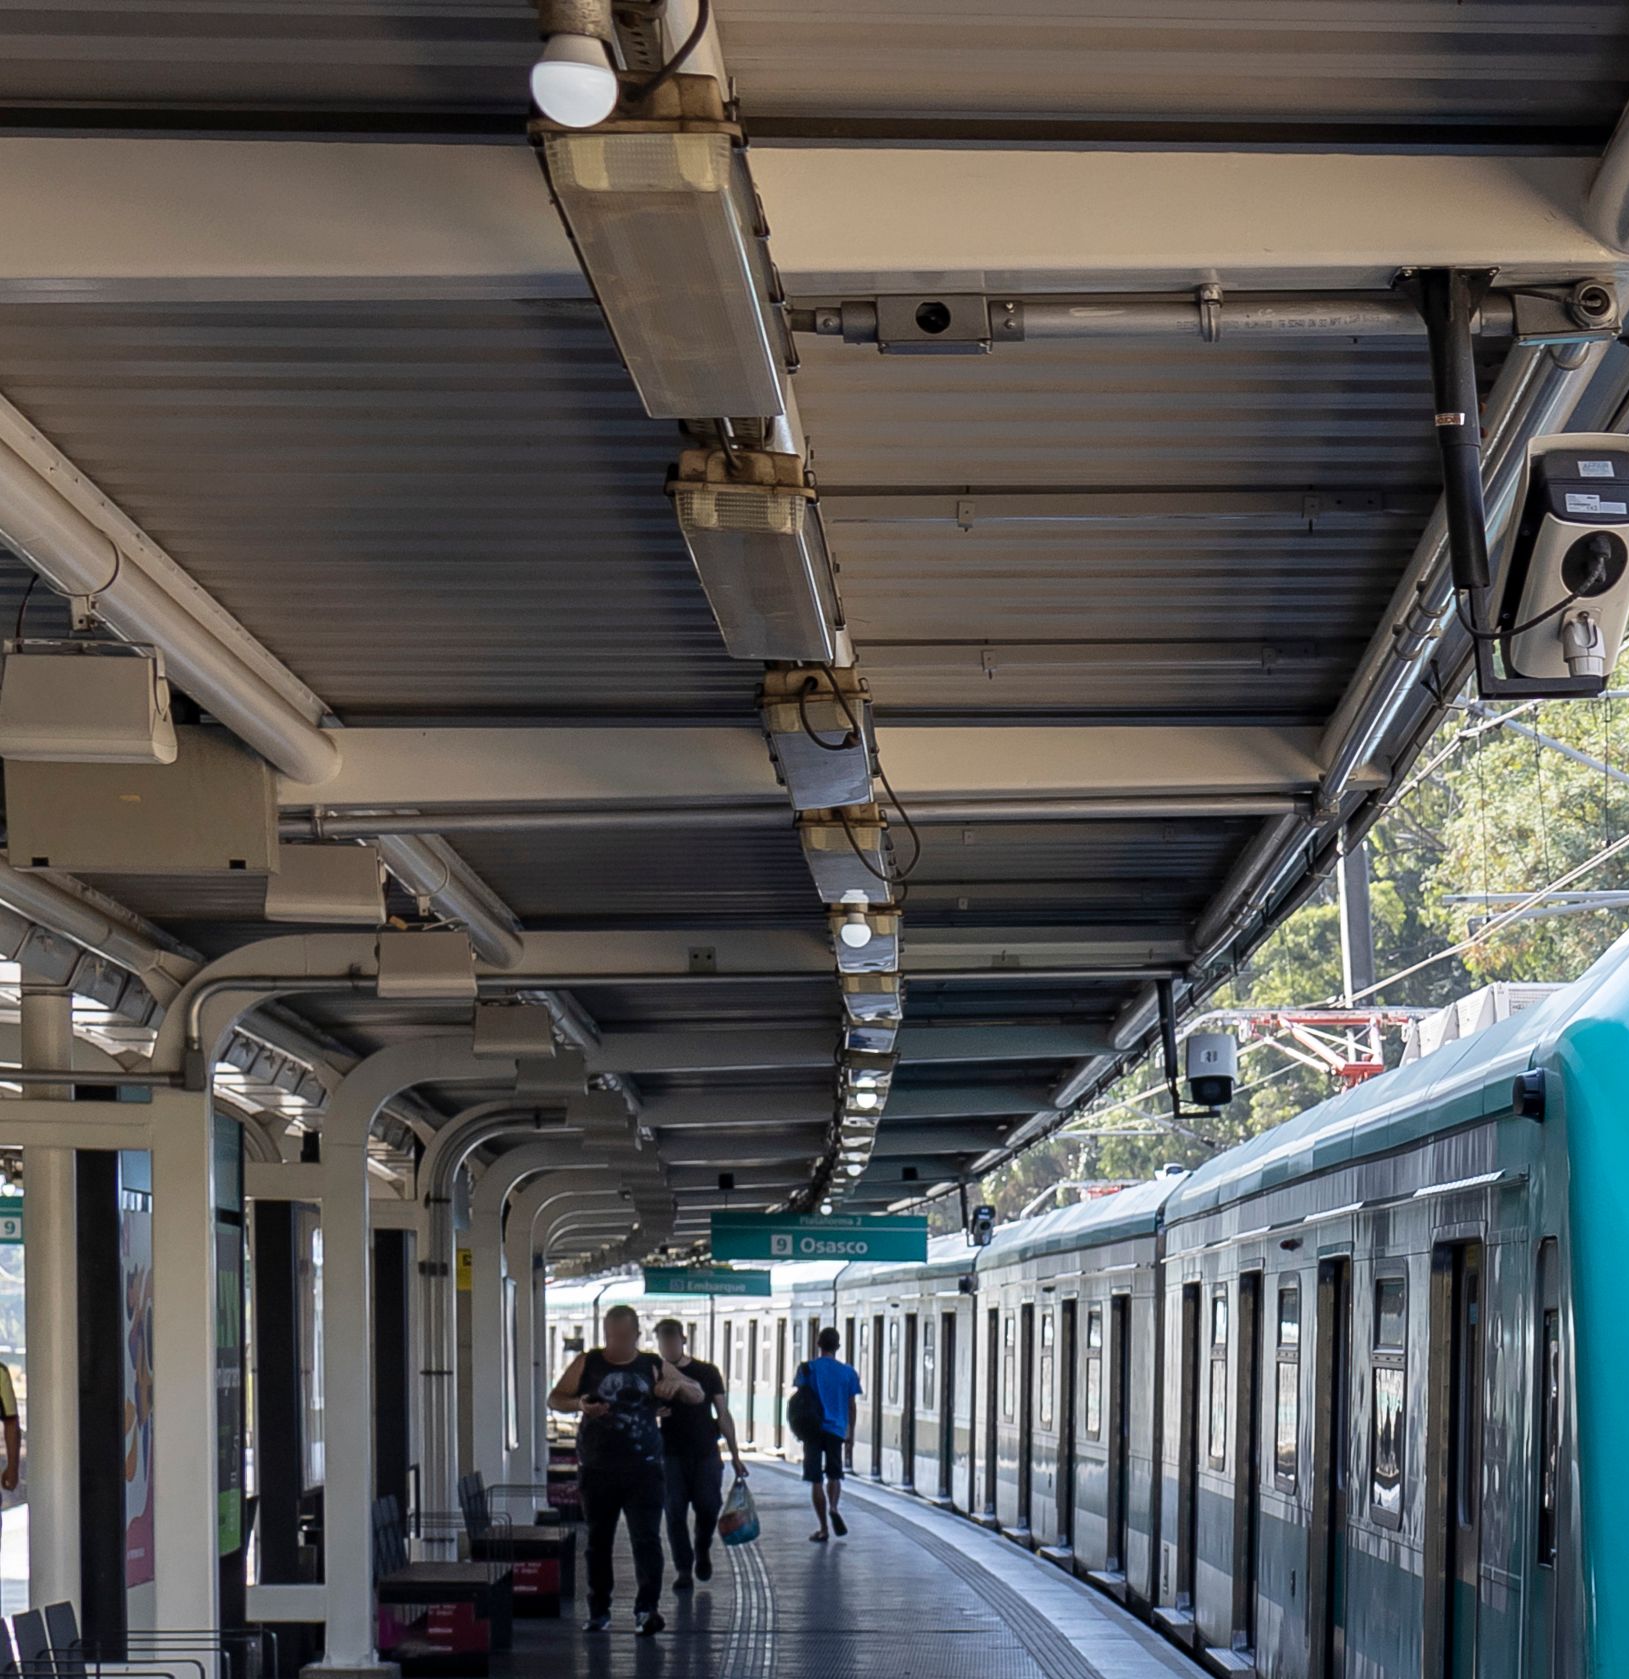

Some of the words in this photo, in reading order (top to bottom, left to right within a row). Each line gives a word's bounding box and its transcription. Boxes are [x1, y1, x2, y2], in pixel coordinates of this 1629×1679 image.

[4, 1220, 15, 1235] 9
[856, 1217, 862, 1226] 2
[776, 1237, 787, 1252] 9
[800, 1237, 868, 1254] Osasco
[687, 1280, 746, 1293] Embarque
